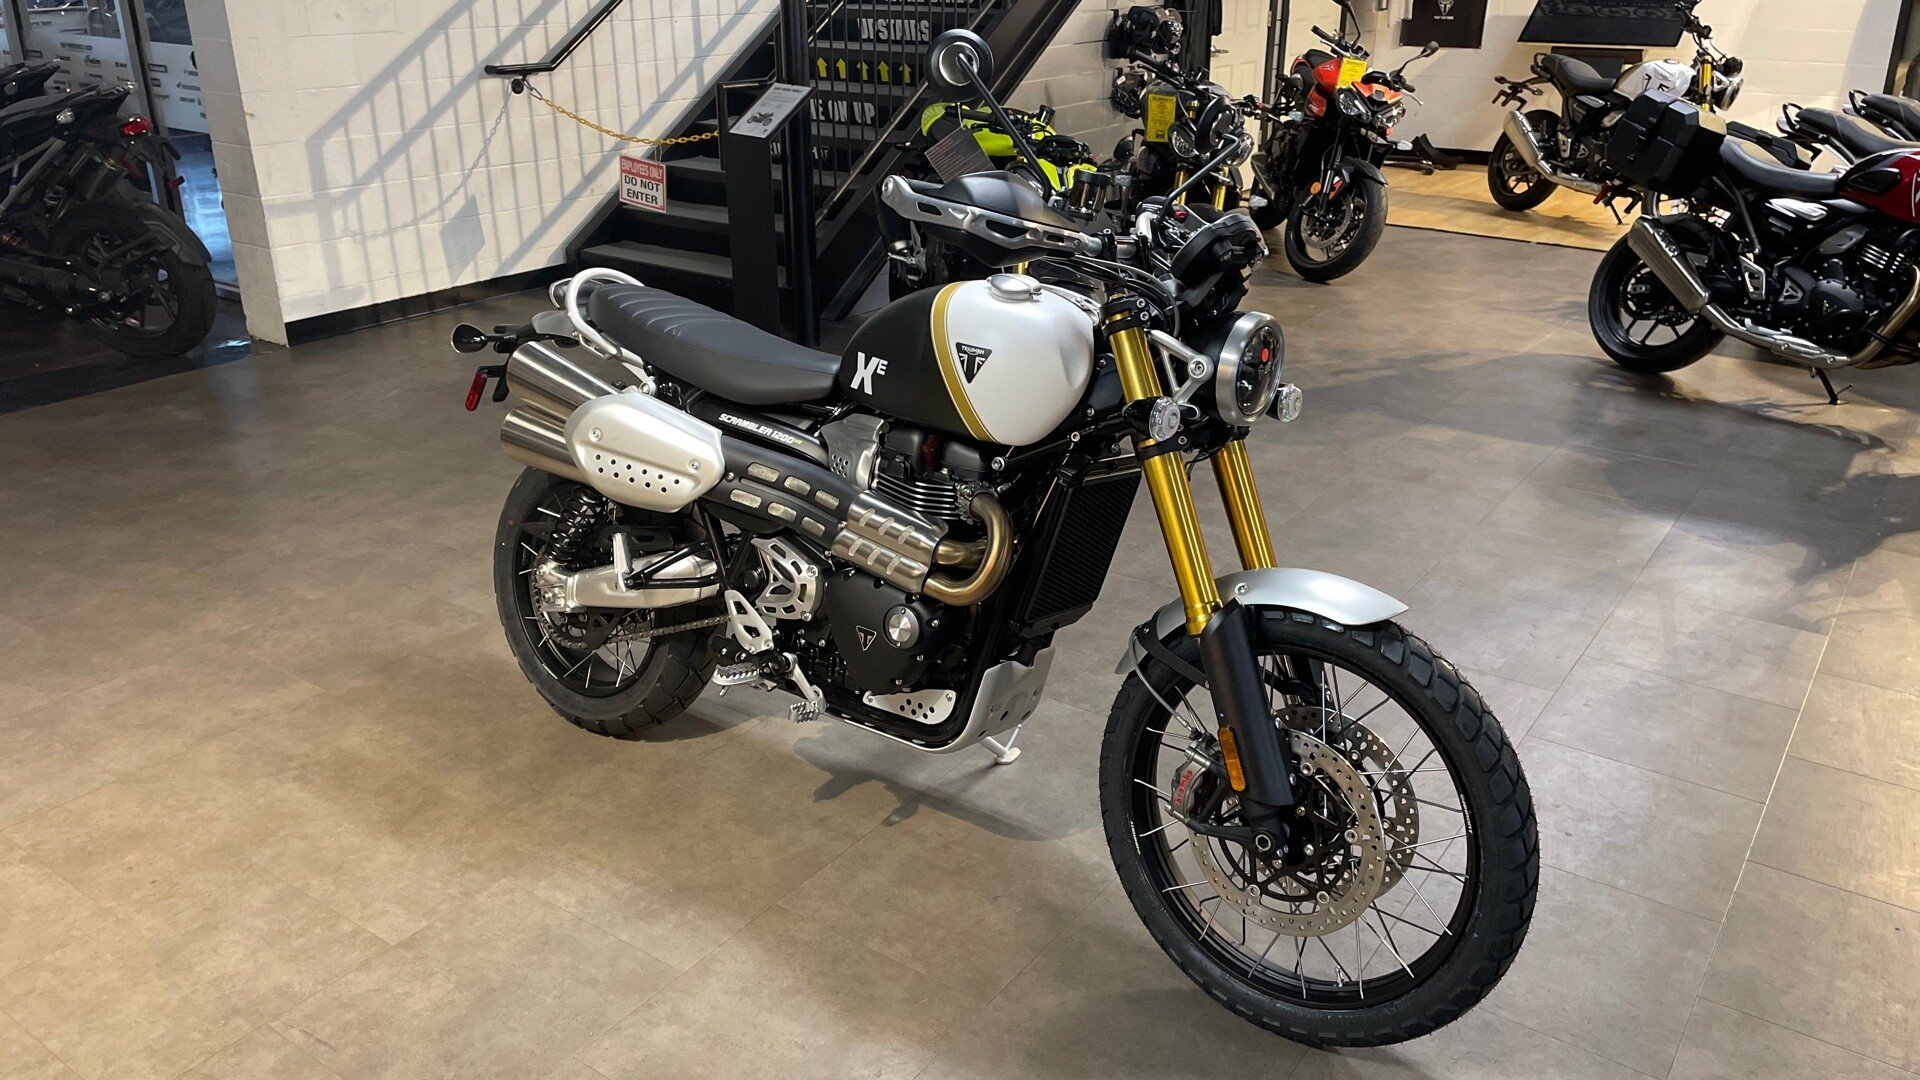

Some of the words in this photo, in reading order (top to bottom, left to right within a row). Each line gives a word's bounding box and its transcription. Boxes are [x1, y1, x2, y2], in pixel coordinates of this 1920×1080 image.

[853, 101, 875, 124] UP
[624, 174, 638, 187] DO
[640, 178, 661, 193] NOT
[626, 188, 658, 205] ENTER
[960, 345, 985, 355] TRIUMPH
[718, 412, 773, 436] SCRAMBLER
[771, 430, 795, 445] 1200
[1174, 770, 1194, 805] brembo
